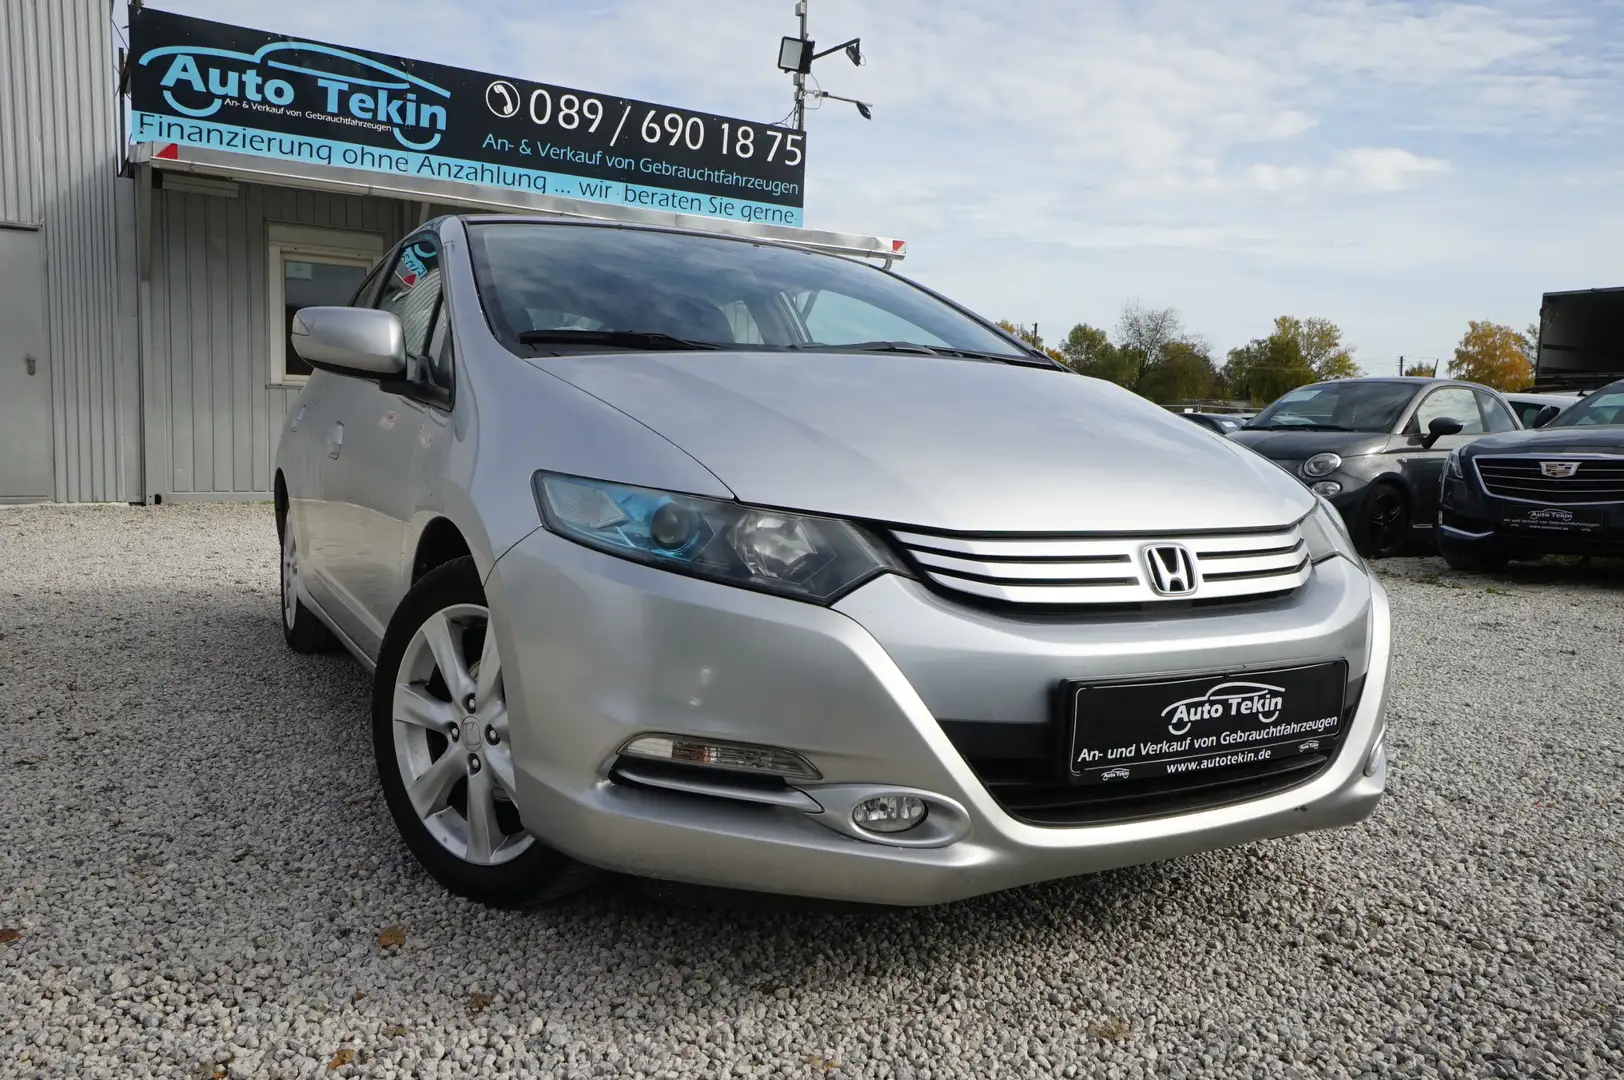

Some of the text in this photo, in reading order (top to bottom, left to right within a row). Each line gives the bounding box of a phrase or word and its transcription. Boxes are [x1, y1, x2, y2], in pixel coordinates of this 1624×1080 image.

[160, 54, 447, 131] Auto Tekin
[224, 98, 392, 132] An- & Verkauf von Gebrauchtfahrzeugen
[529, 88, 802, 166] 089 / 690 18 75
[140, 113, 333, 165] Finanzierung
[342, 146, 409, 173] ohne
[417, 155, 547, 193] Anzahlung
[579, 180, 613, 200] wir
[624, 184, 702, 212] beraten
[709, 195, 735, 217] Sie
[741, 204, 794, 224] gerne
[482, 133, 799, 195] An- & Verkauf von Gebrauchtfahrzeugen
[1172, 694, 1282, 724] Auto Tekin
[1078, 715, 1338, 763] An- und Verkauf von Gebrauchtfahrzeugen
[1166, 749, 1272, 774] www.autotekin.de
